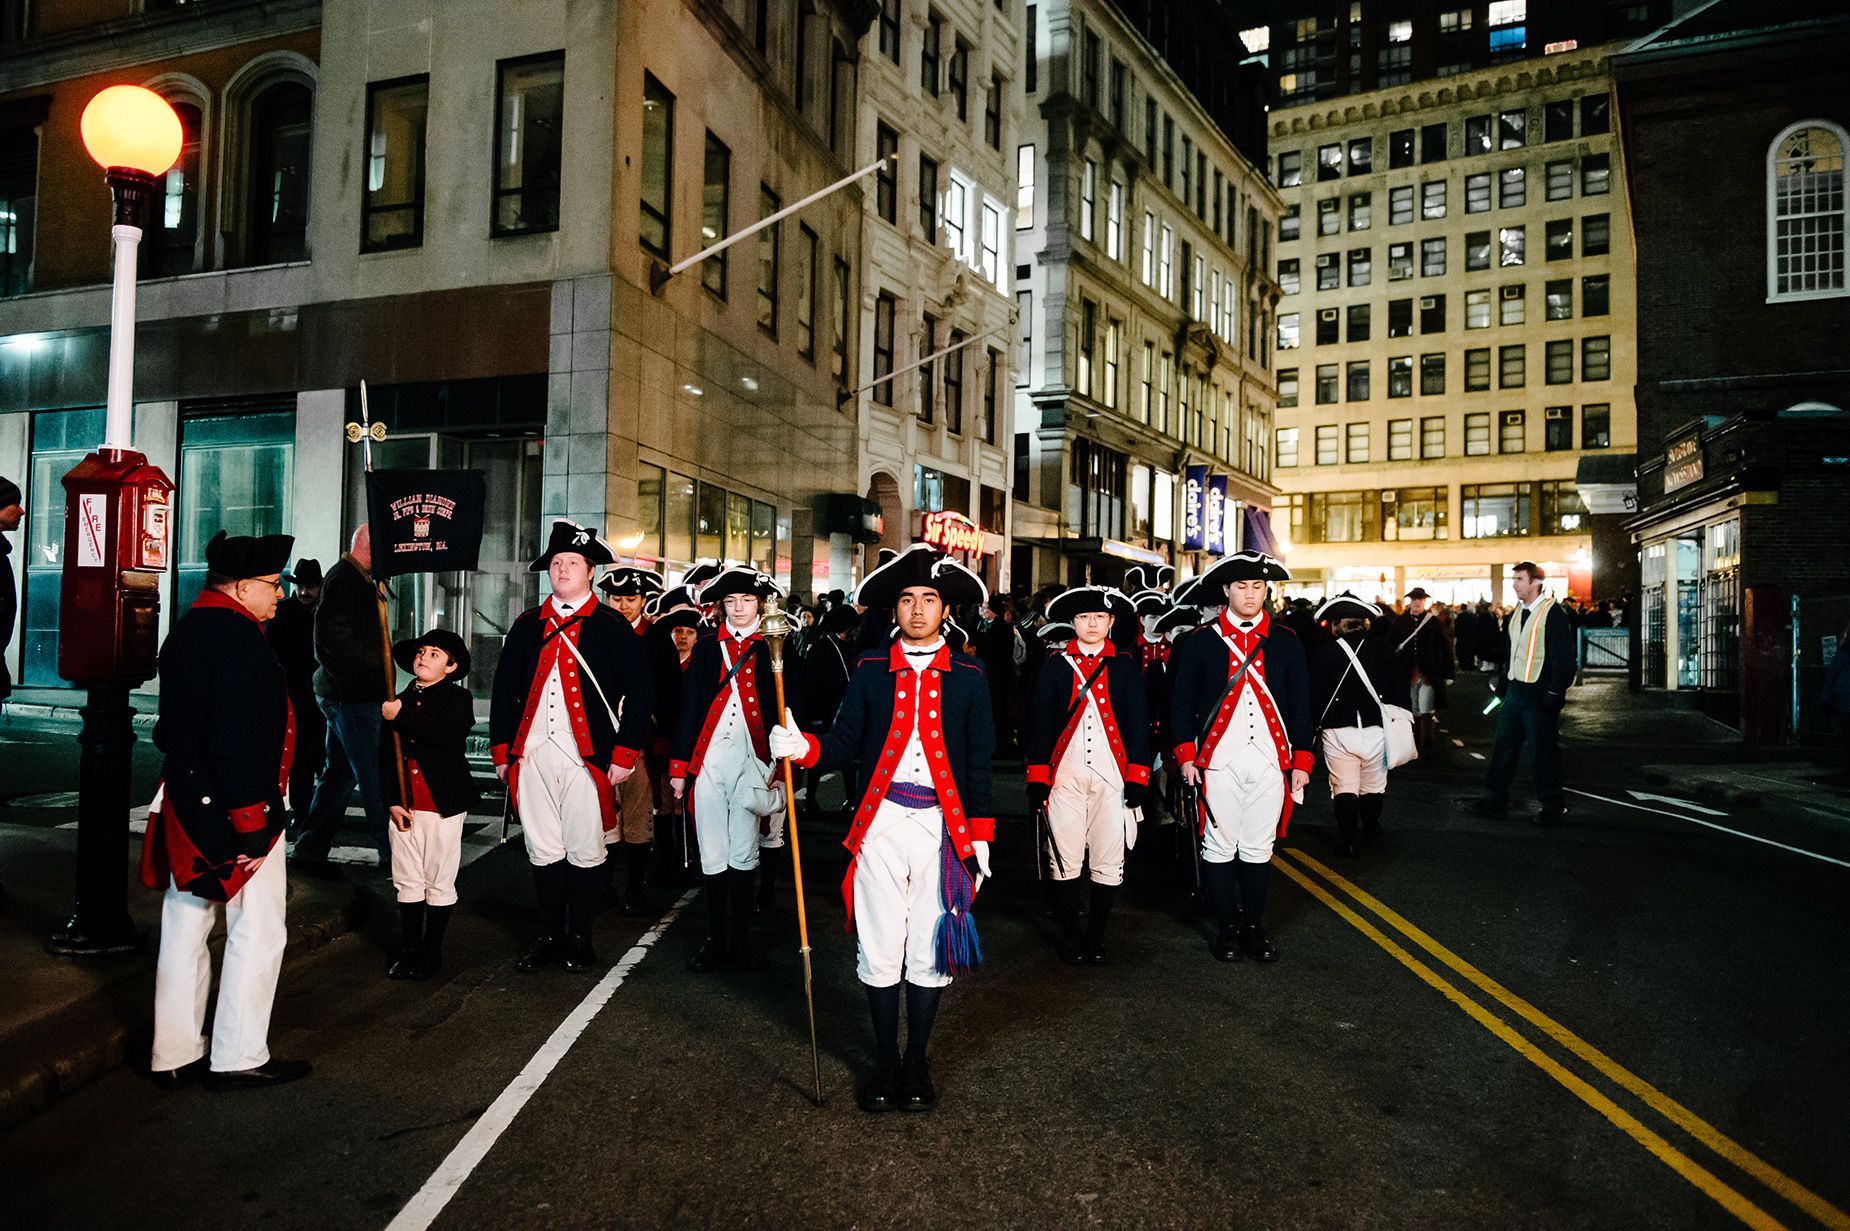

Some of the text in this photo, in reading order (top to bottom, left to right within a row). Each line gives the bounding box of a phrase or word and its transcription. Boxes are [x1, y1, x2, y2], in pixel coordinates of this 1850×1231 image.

[148, 488, 163, 497] FIRE
[390, 494, 422, 511] WILLIAM
[1187, 479, 1202, 539] claire's
[86, 498, 101, 531] FIRE
[1210, 487, 1224, 545] claire's
[924, 513, 984, 560] Sir Speedy
